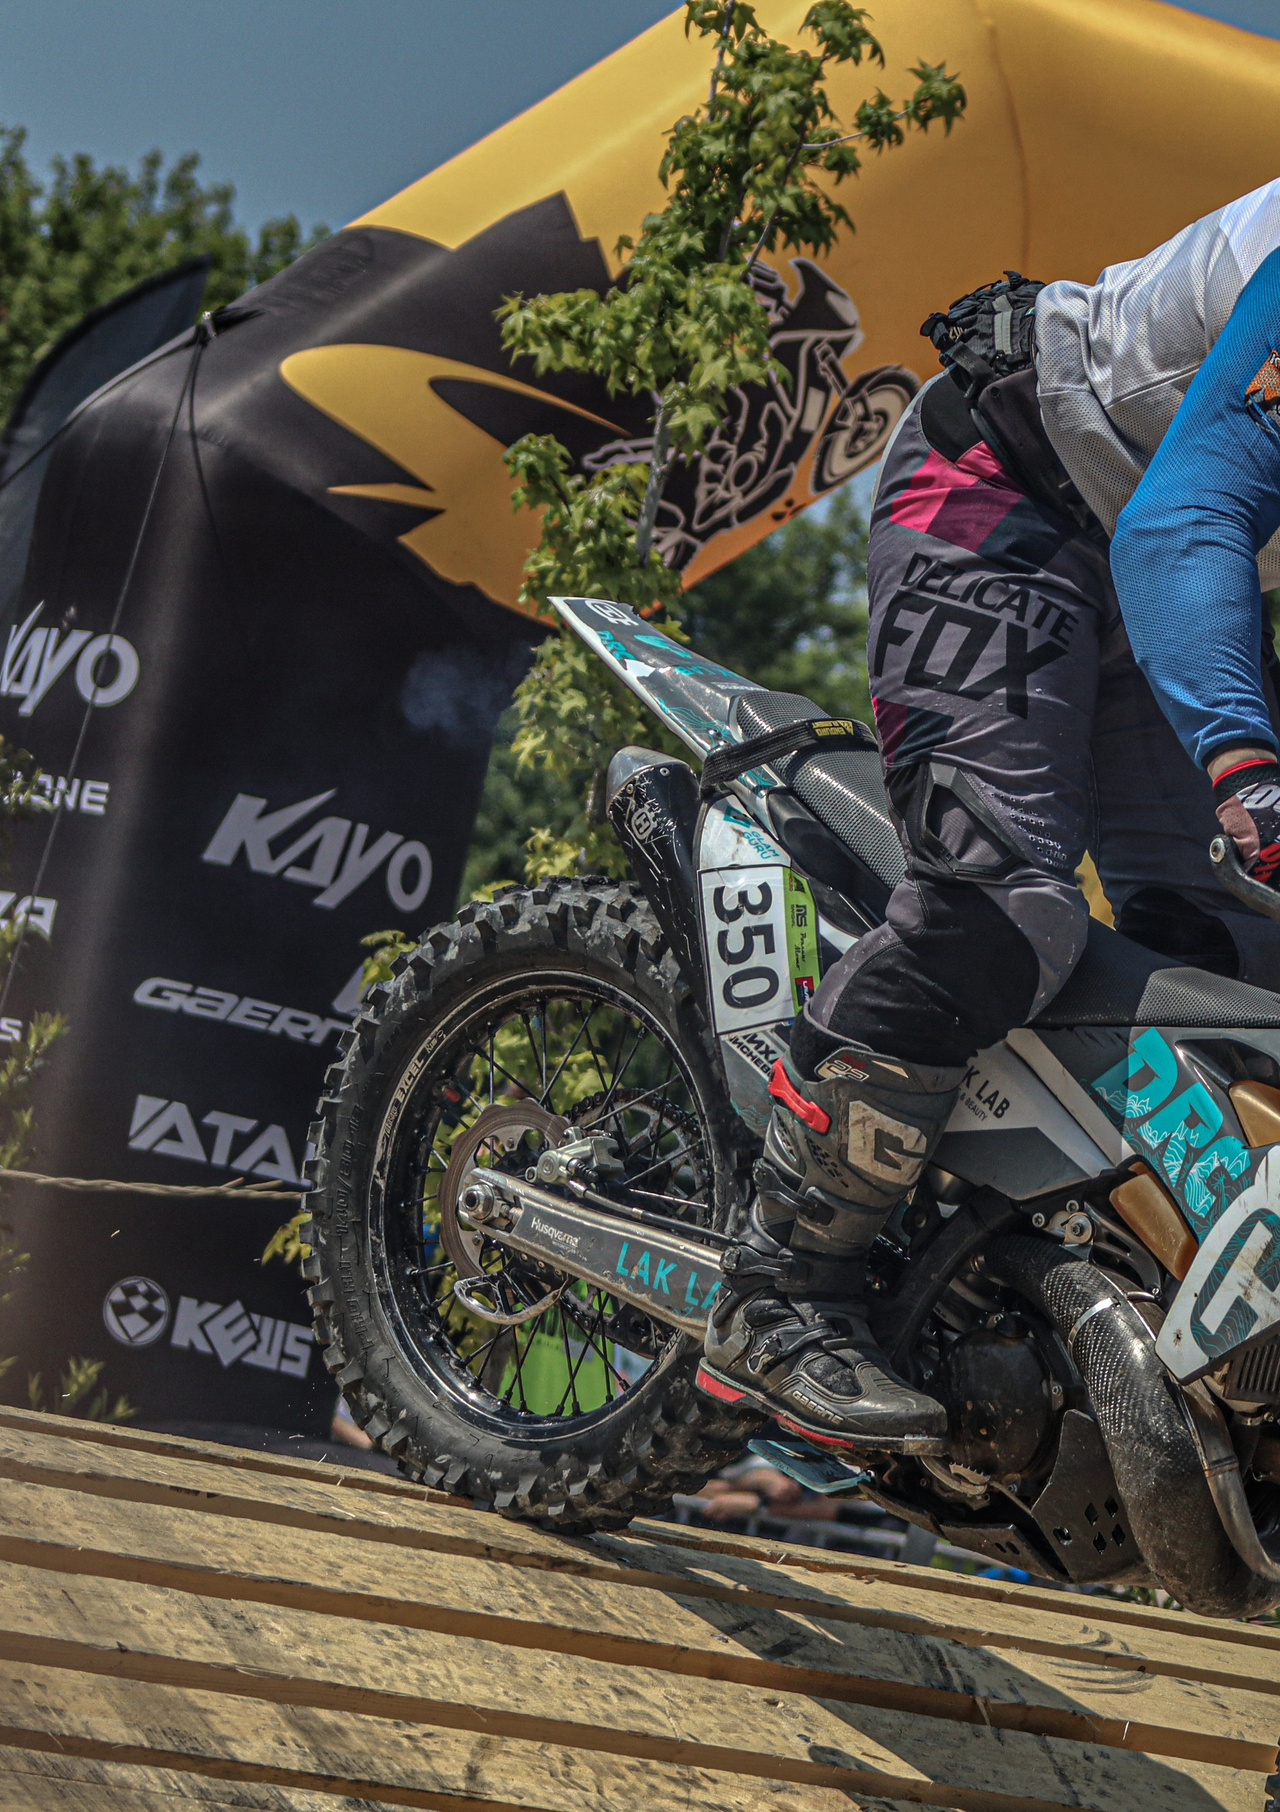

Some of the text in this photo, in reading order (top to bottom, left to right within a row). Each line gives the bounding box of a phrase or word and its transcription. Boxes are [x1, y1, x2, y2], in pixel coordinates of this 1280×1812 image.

[900, 552, 1079, 646] DELICATE
[874, 589, 1069, 720] FOX
[202, 787, 432, 913] KAYO
[713, 881, 779, 1009] 350
[398, 1058, 425, 1105] EXCEL
[975, 1080, 1010, 1119] LAB
[964, 1098, 988, 1121] BEAUTY
[530, 1216, 581, 1248] Husqvarna
[615, 1241, 677, 1295] LAK
